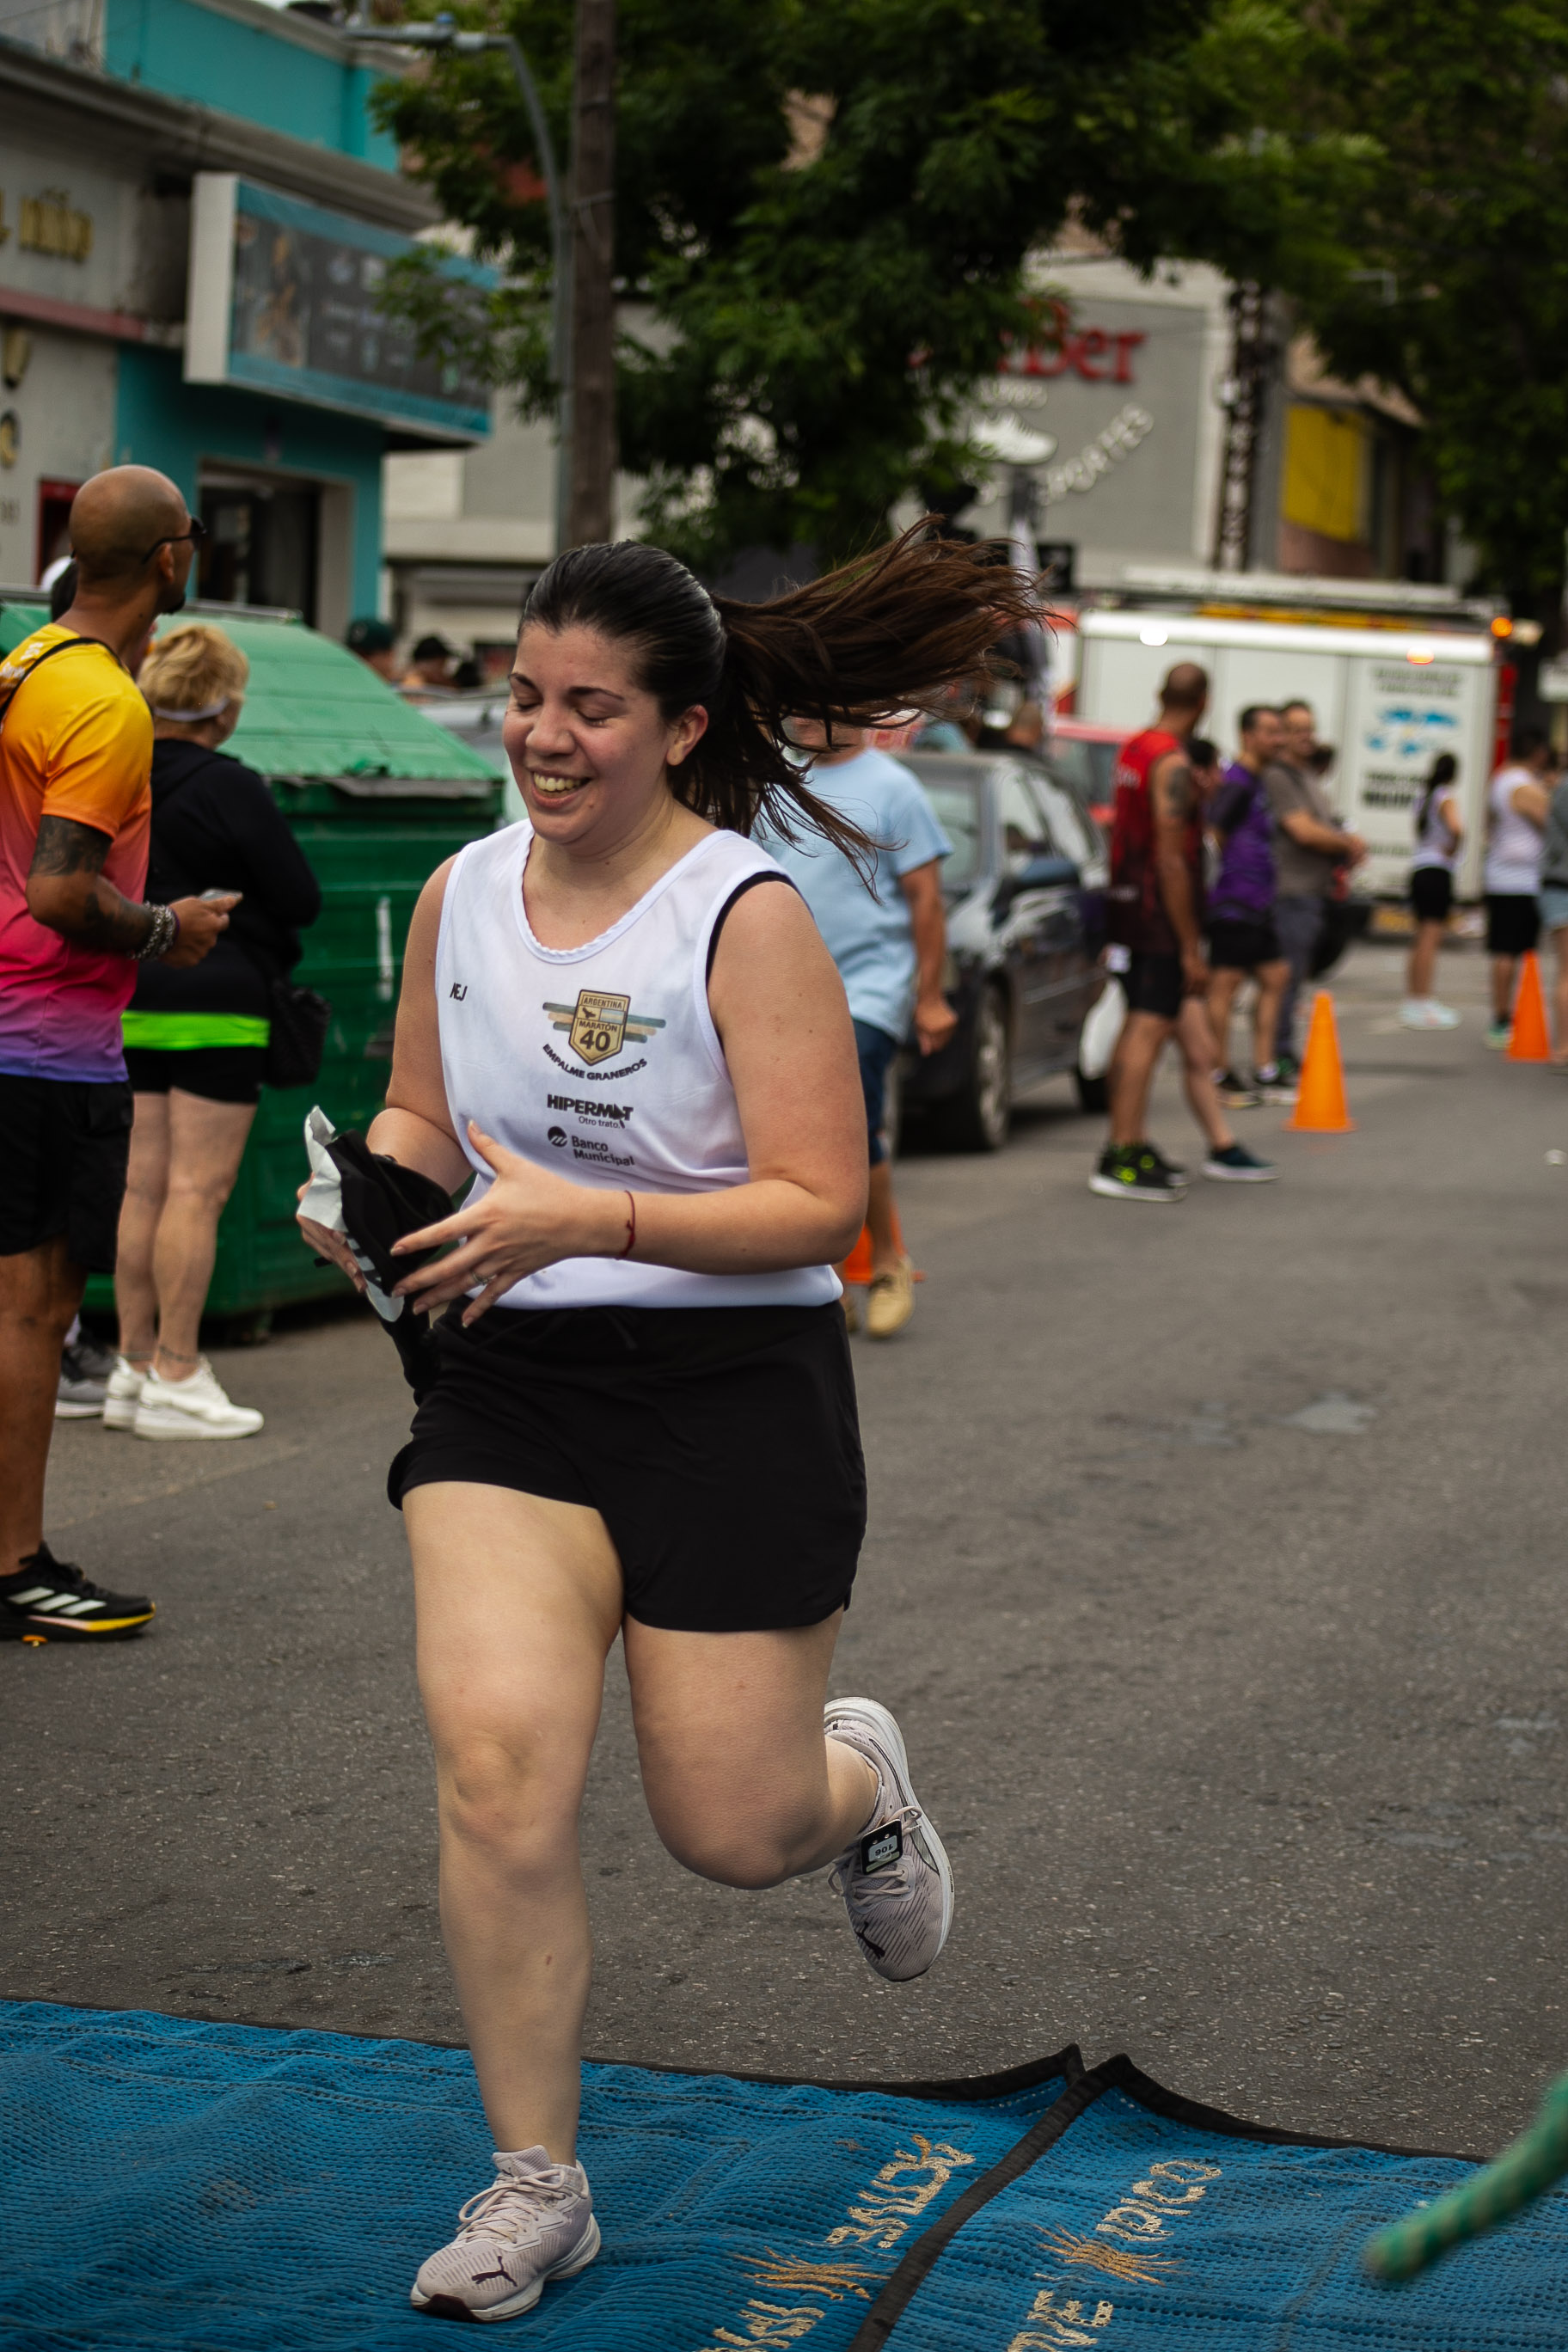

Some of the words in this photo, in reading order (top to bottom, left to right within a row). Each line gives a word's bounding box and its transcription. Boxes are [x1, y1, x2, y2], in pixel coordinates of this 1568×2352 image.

[583, 997, 622, 1009] ARGENTINA
[579, 1020, 618, 1032] MARATÓN
[579, 1029, 611, 1052] 40
[542, 1044, 585, 1079] EMPALME
[586, 1058, 648, 1081] GRANEROS
[578, 1116, 597, 1126] Otro
[571, 1136, 609, 1152] Banco
[573, 1148, 635, 1167] Municipal
[875, 1844, 893, 1856] 106
[1096, 2159, 1222, 2243] IPICO
